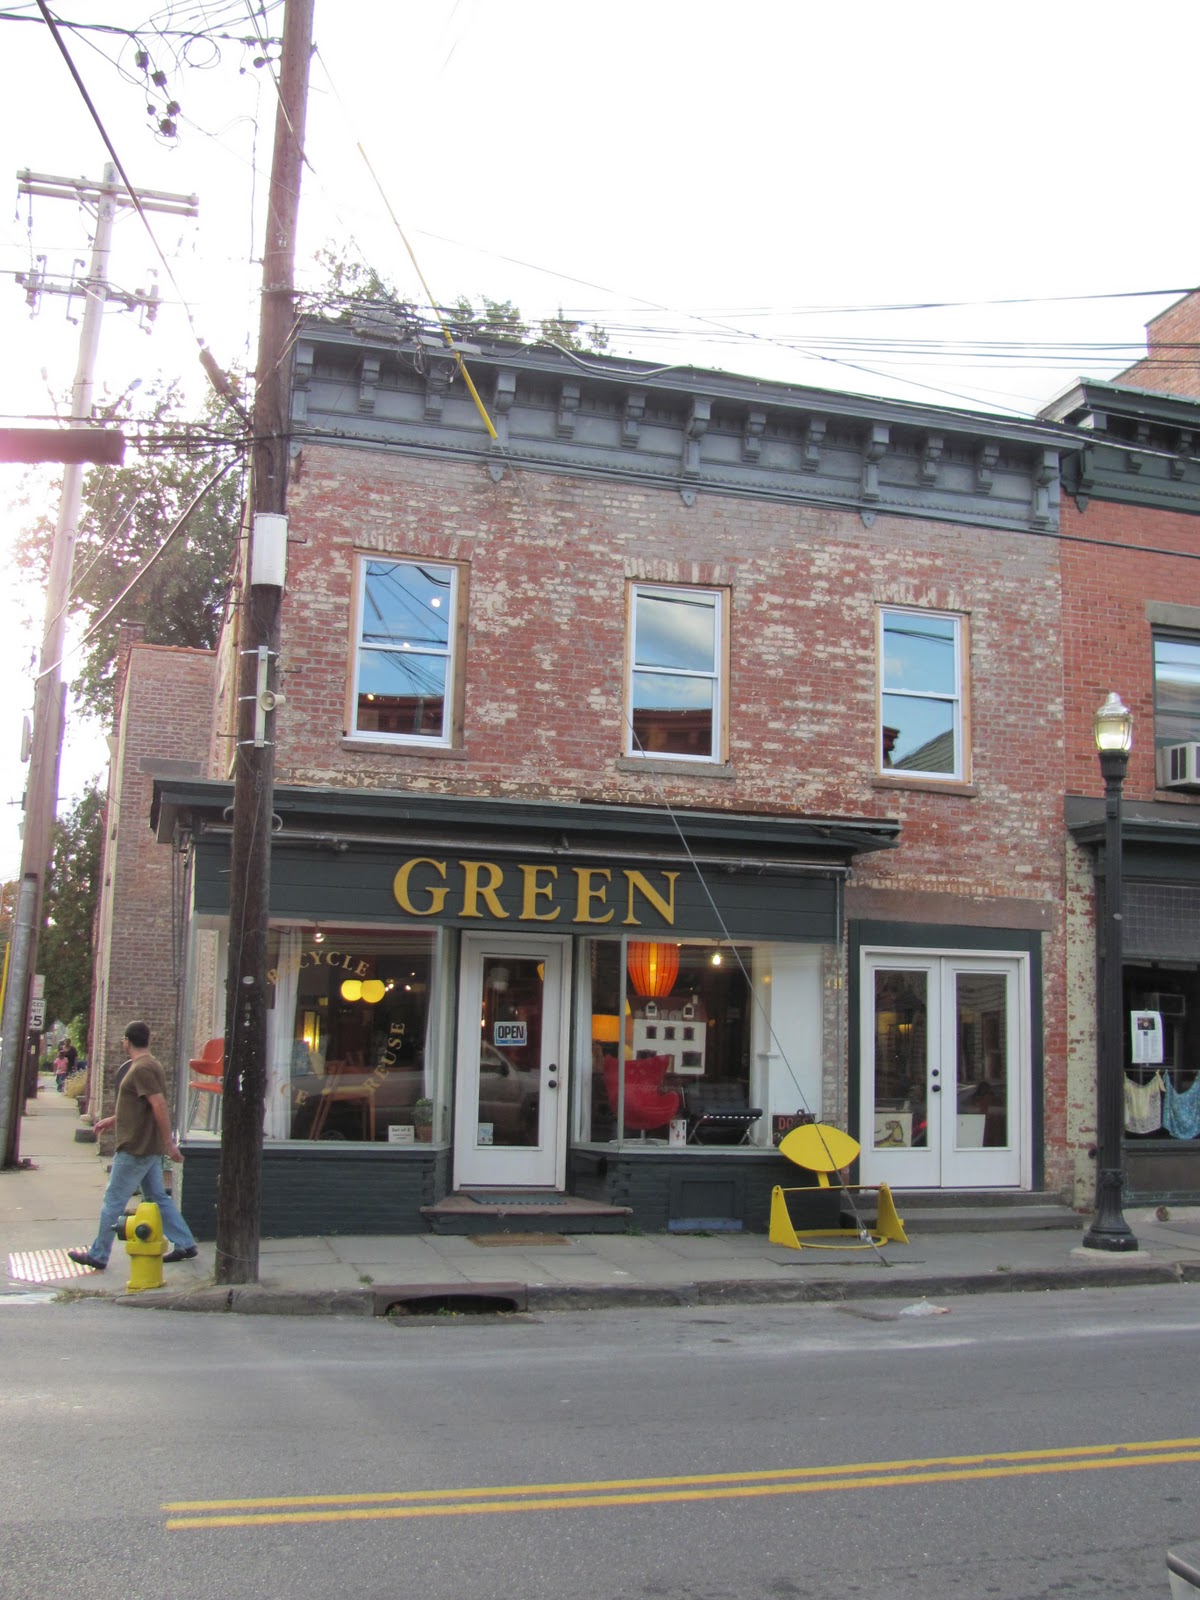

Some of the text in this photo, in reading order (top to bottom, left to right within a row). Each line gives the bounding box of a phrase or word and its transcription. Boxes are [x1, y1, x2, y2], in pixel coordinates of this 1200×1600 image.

[393, 857, 680, 925] GREEN
[362, 1022, 406, 1089] REUSE
[497, 1025, 524, 1039] OPEN
